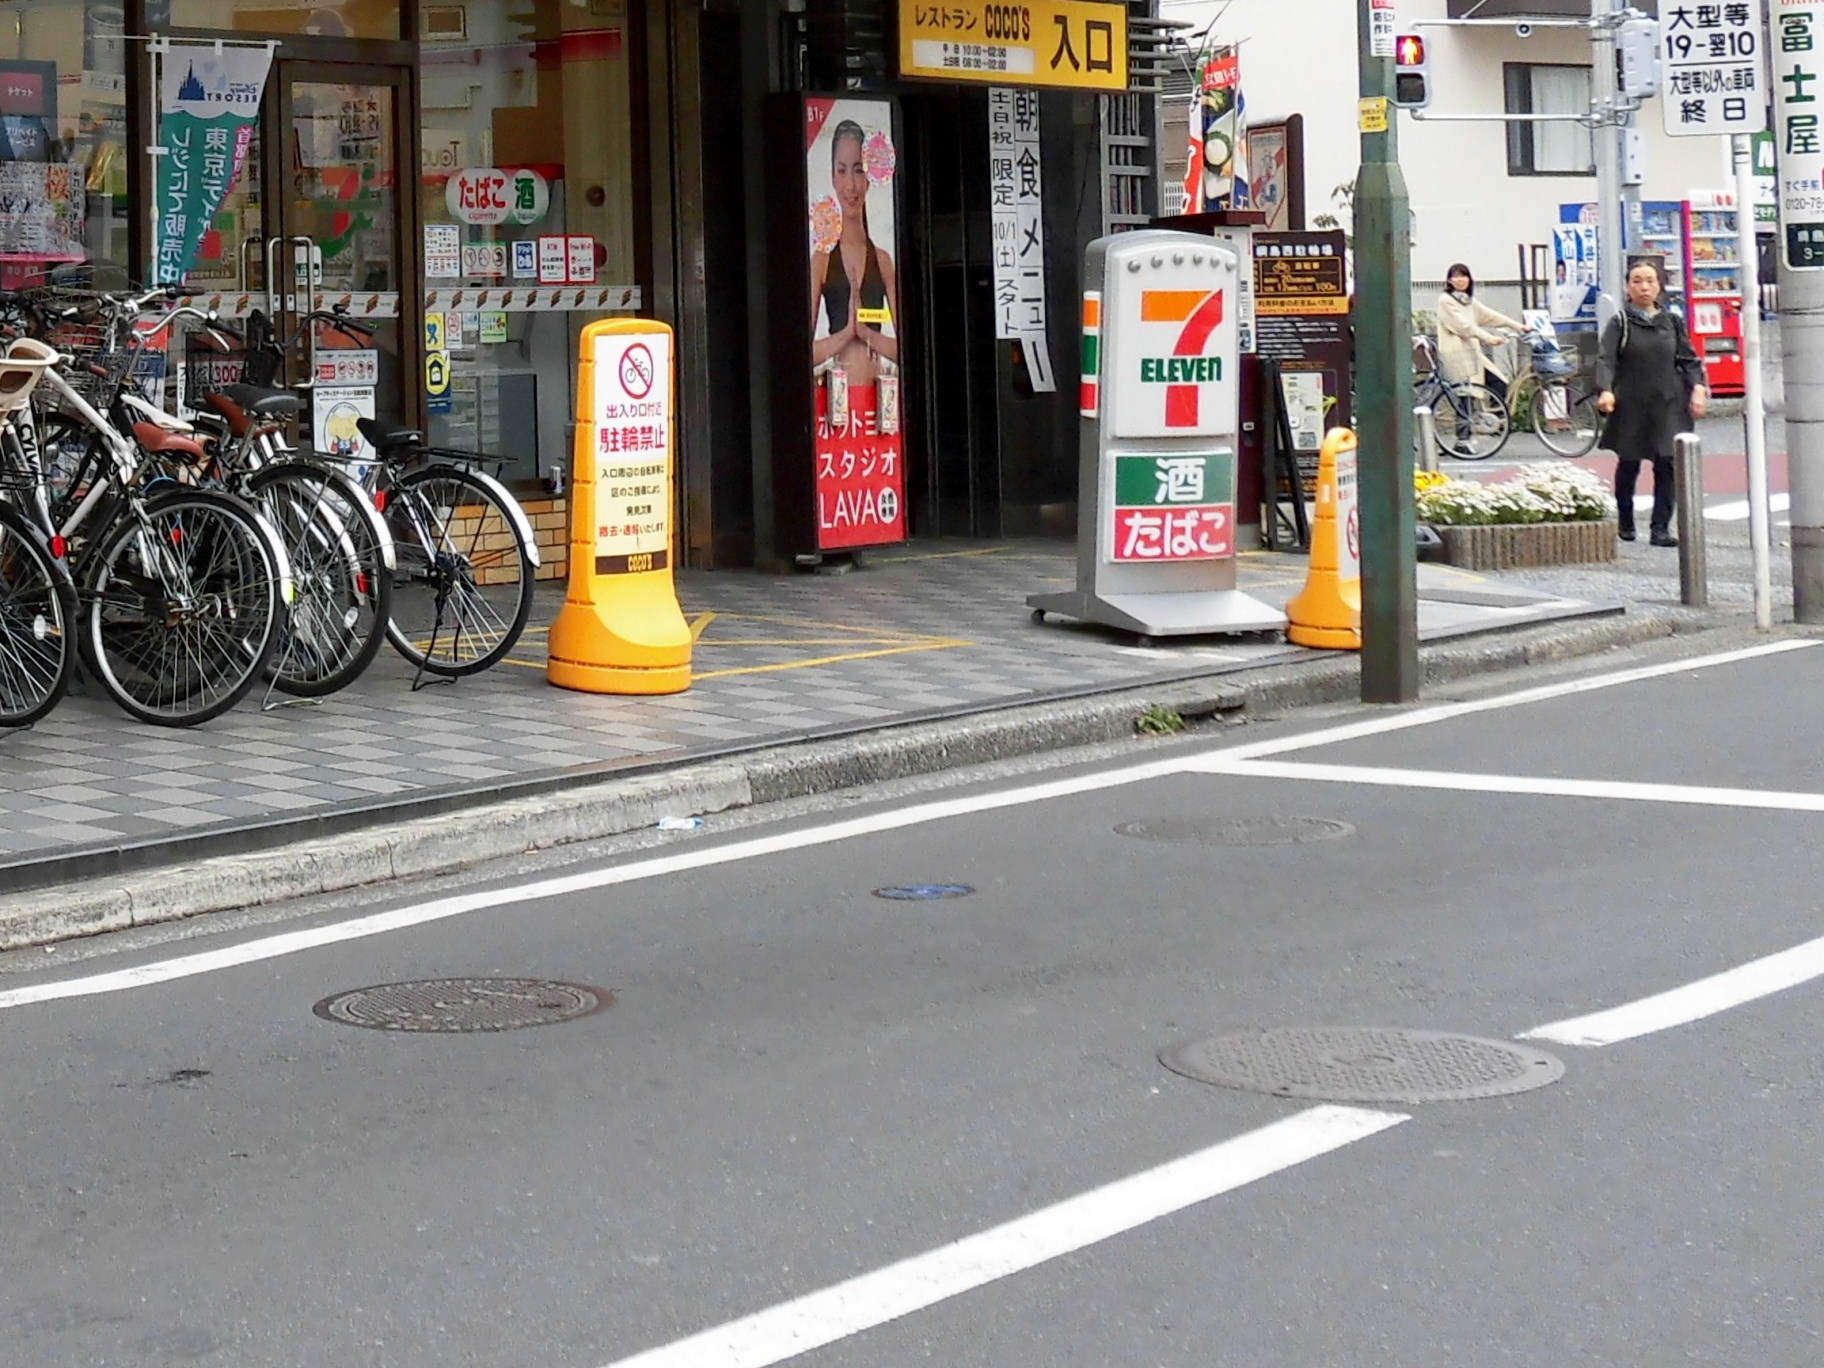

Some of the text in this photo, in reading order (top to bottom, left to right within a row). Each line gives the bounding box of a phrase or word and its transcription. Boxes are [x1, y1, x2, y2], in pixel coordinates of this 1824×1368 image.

[1668, 3, 1750, 30] 大型等
[915, 4, 1113, 74] レストラン COCO'S 入口
[1669, 65, 1755, 95] 大型等以外の車両
[458, 176, 535, 209] たばこ 酒
[606, 401, 662, 419] 出入り口付近
[599, 424, 665, 453] 駐輪禁止
[819, 447, 897, 481] スタジオ
[1155, 458, 1206, 503] 酒
[819, 488, 879, 529] LAVA
[1124, 511, 1227, 558] たばこ
